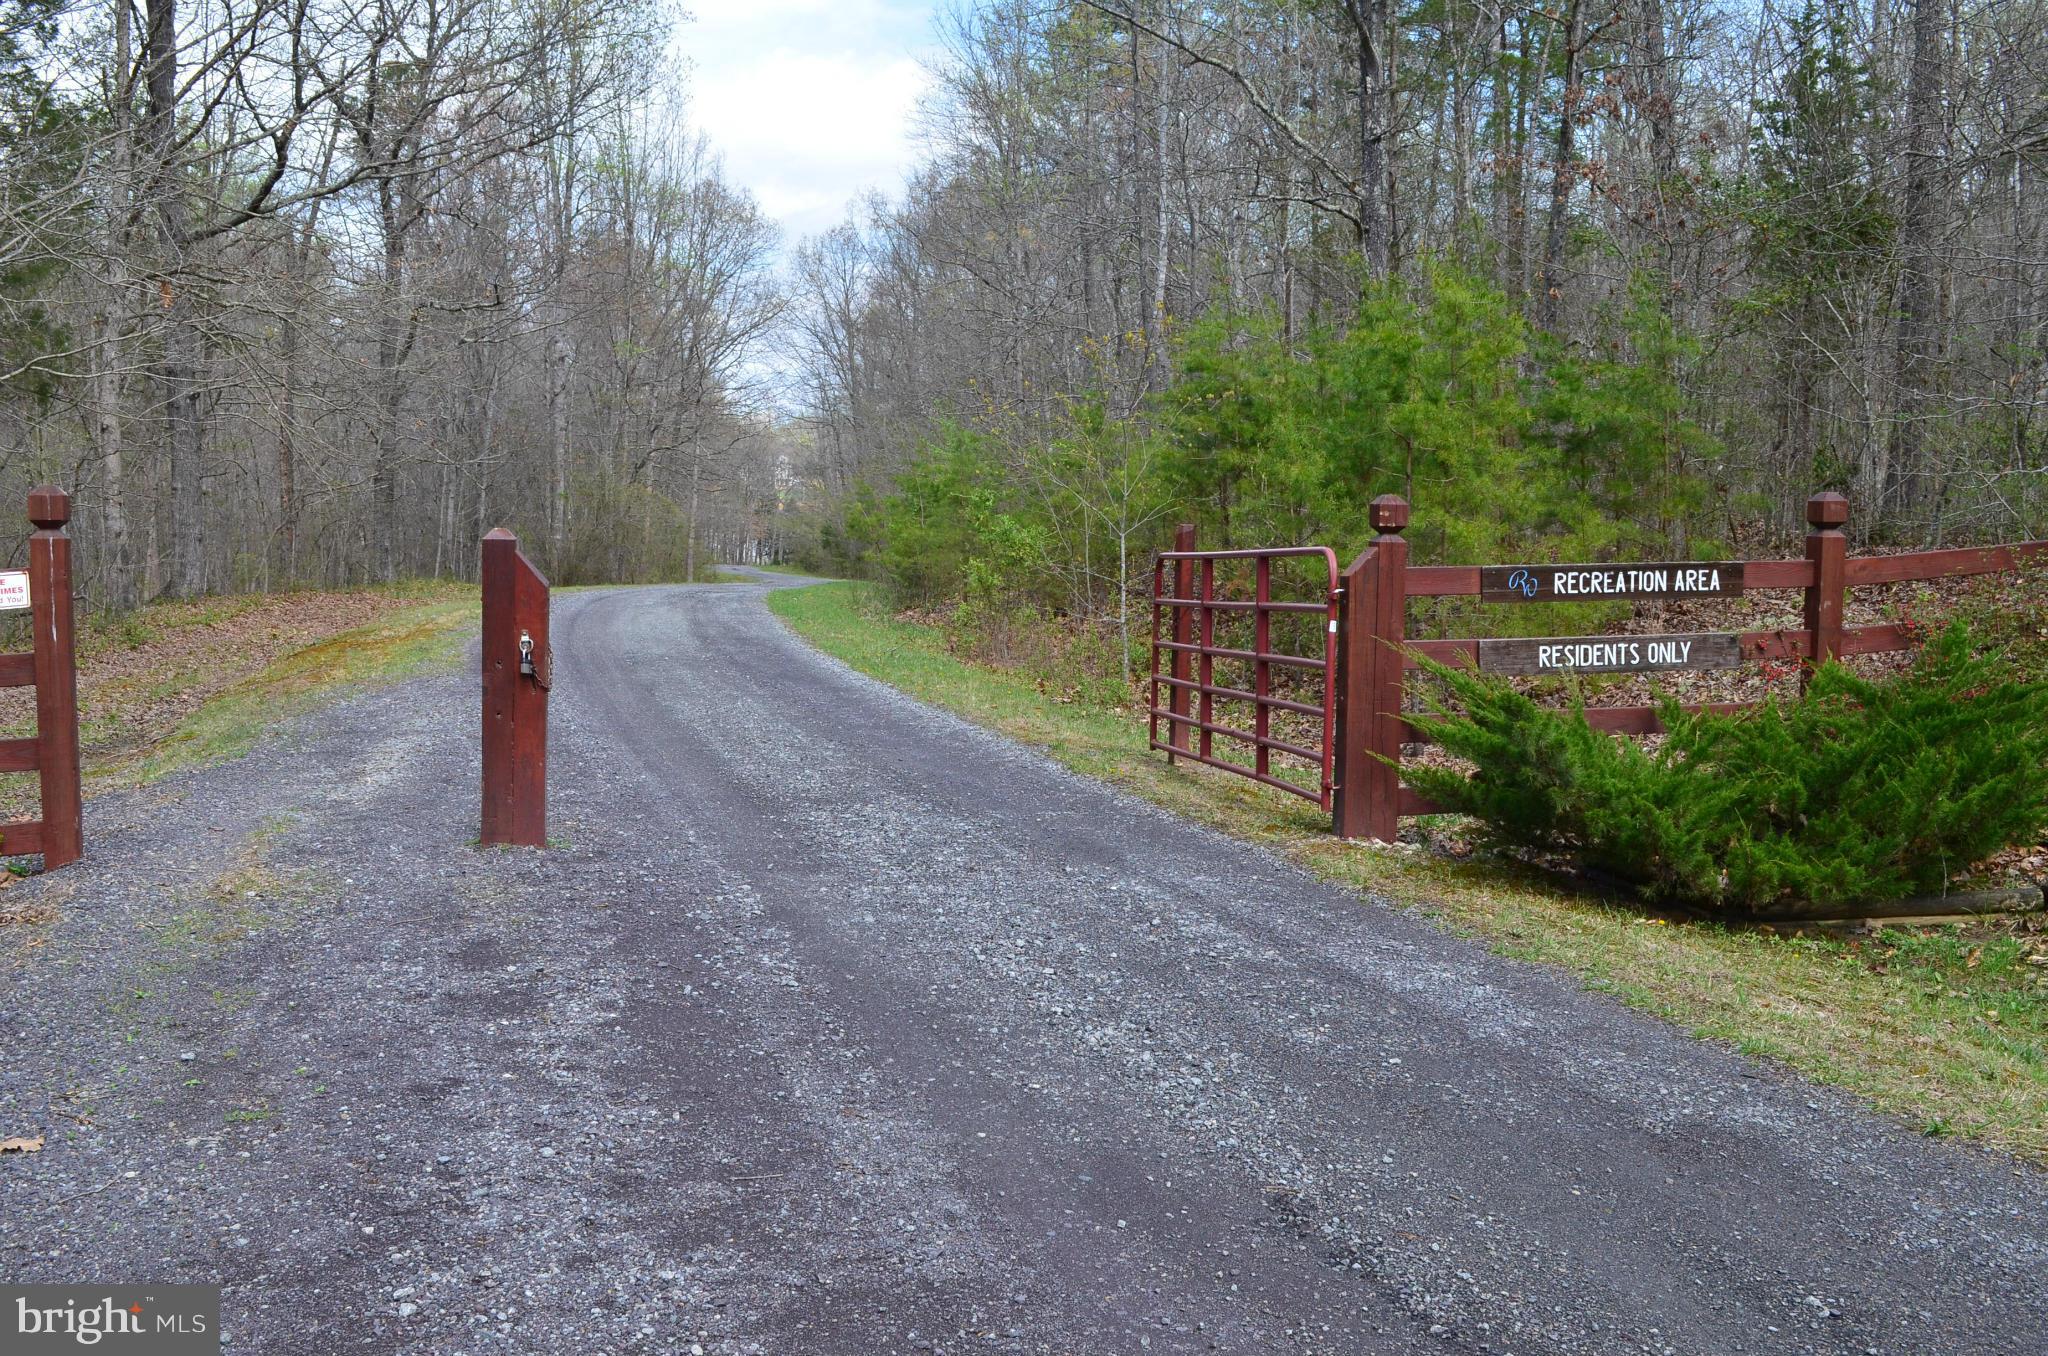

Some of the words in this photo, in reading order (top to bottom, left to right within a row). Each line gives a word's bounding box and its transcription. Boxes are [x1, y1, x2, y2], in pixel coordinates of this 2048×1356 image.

[1554, 571, 1667, 594] RECREATION
[1674, 569, 1720, 591] AREA
[1539, 643, 1640, 668] RESIDENTS
[1648, 641, 1691, 663] ONLY
